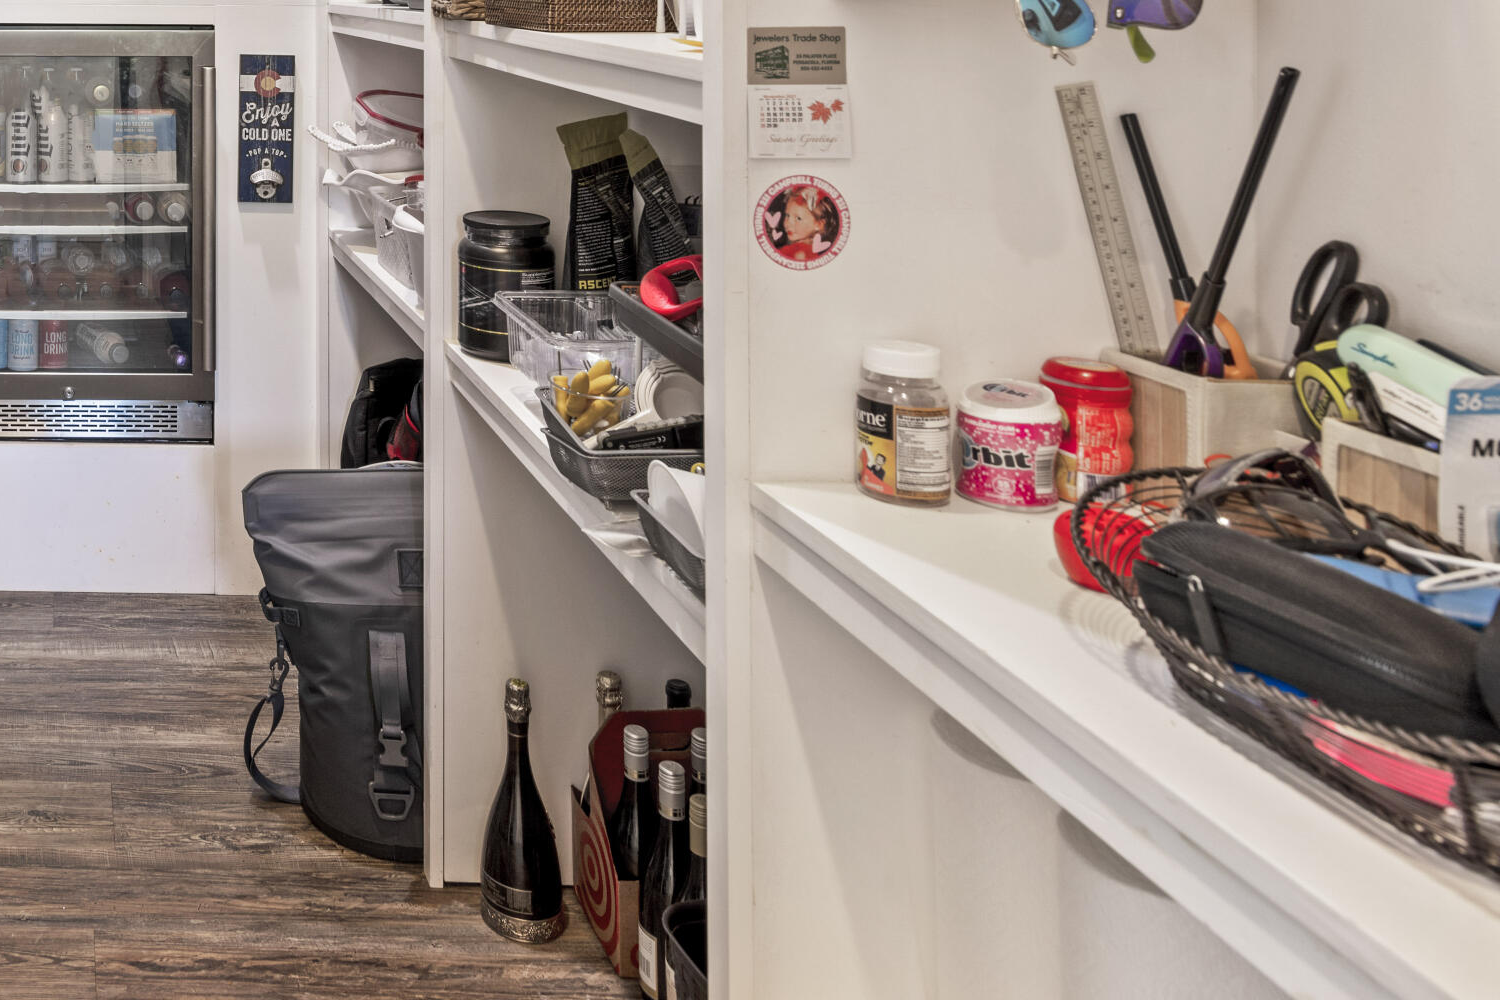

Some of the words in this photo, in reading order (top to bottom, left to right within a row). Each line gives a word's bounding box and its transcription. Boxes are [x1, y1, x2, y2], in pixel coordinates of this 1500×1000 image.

[753, 33, 790, 45] Jewelers
[792, 33, 817, 42] Trade
[819, 33, 841, 44] Shop
[242, 102, 292, 124] Enjoy
[270, 117, 280, 127] A
[242, 127, 269, 141] COLD
[271, 128, 292, 142] ONE
[248, 147, 262, 157] POP
[271, 147, 285, 157] TOP
[11, 332, 34, 344] LONG
[45, 331, 67, 342] LONG
[43, 342, 68, 355] DRINK
[1454, 391, 1483, 412] 36
[855, 408, 887, 428] orne
